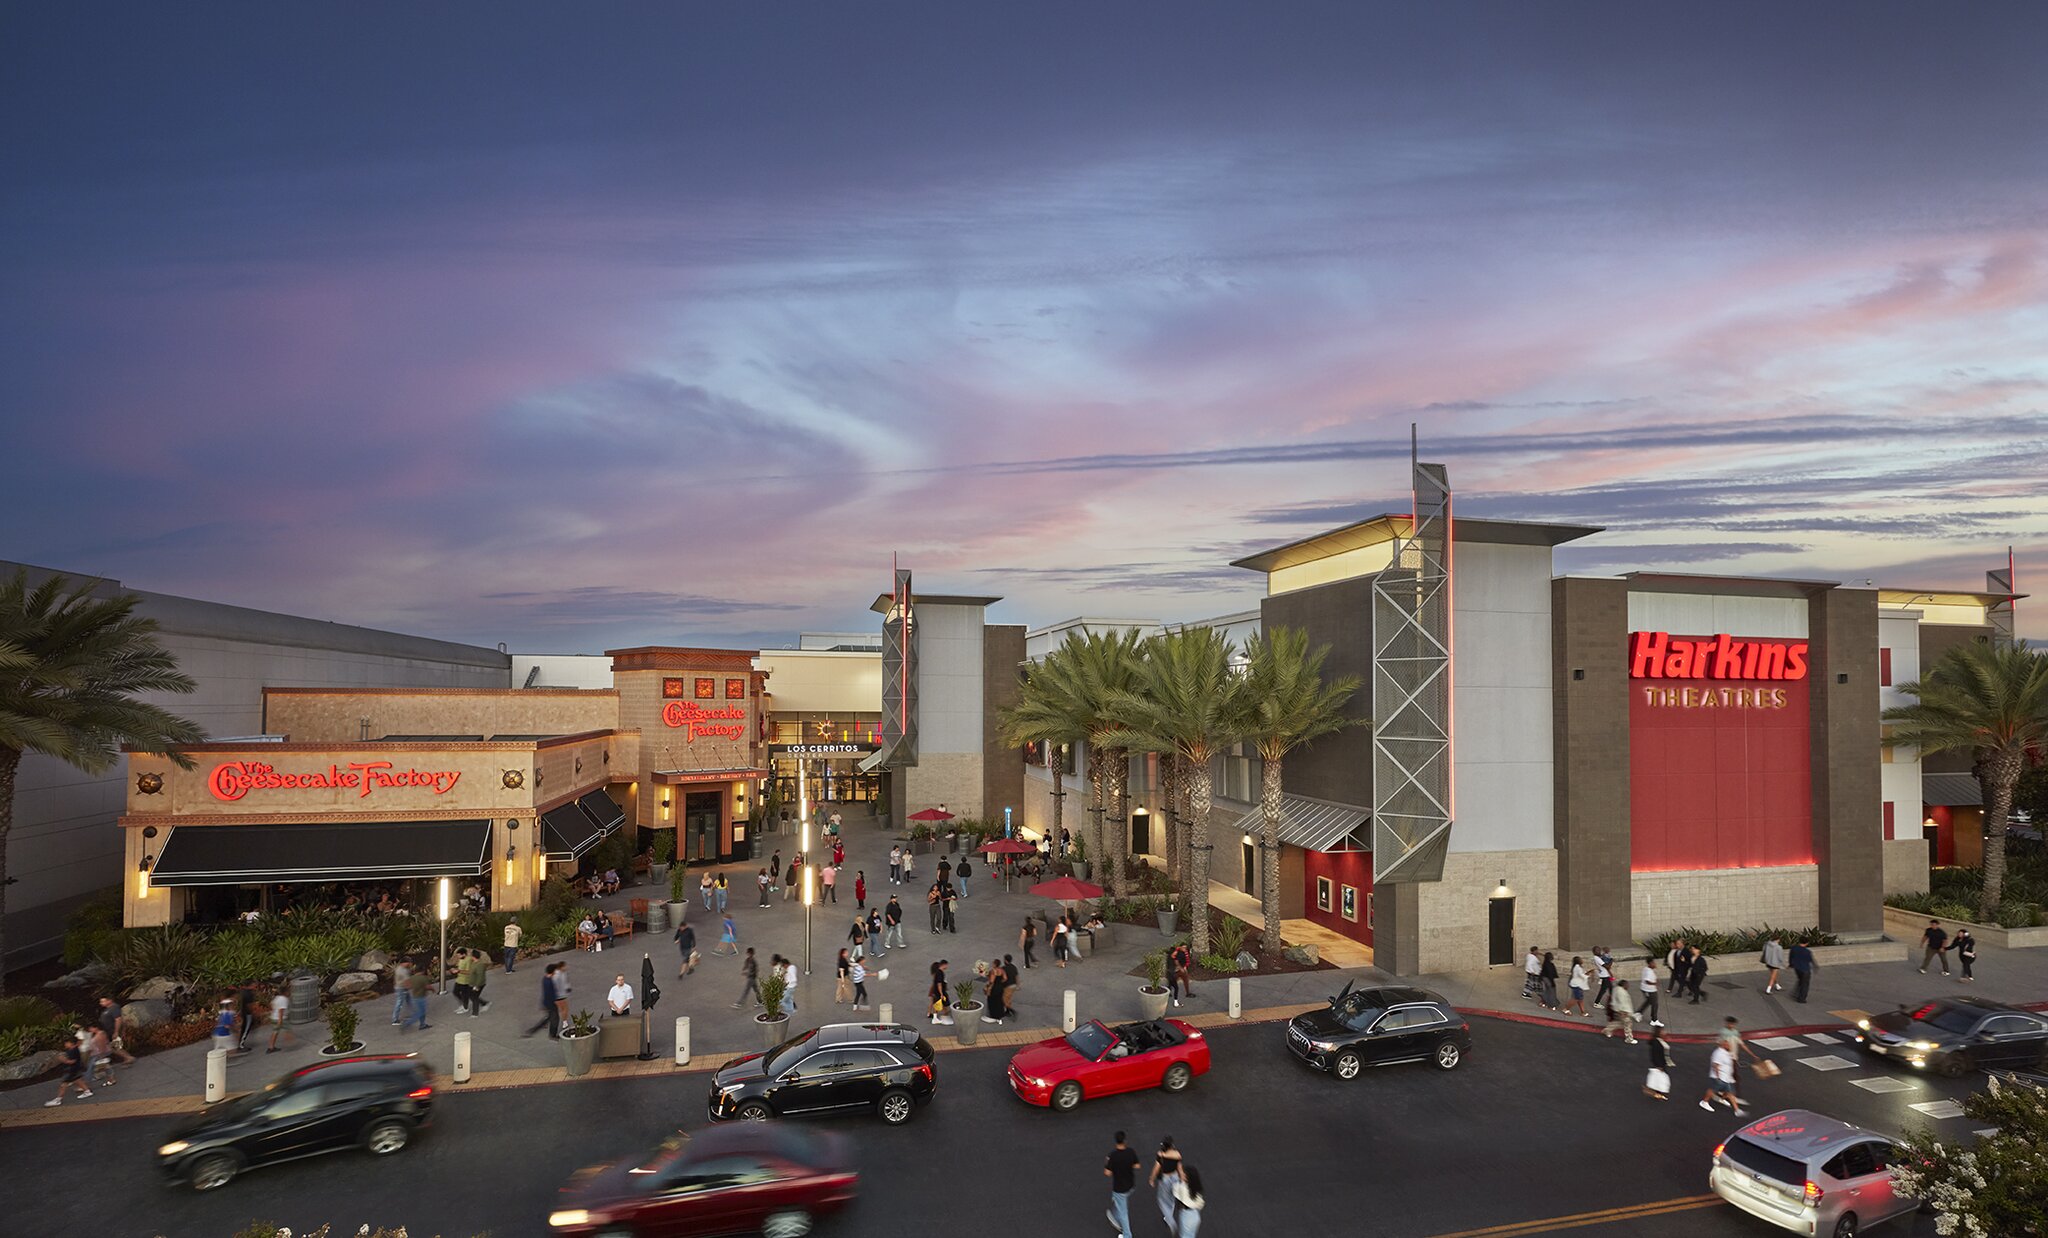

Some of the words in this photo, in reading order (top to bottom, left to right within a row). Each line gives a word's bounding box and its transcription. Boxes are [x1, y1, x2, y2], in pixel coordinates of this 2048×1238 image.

[1631, 631, 1808, 680] Harkins
[1647, 687, 1788, 709] THEATRES
[662, 701, 745, 728] Cheesecake
[681, 718, 745, 744] Factory
[787, 745, 806, 753] LOS
[809, 744, 858, 753] CERRITOS
[246, 761, 274, 773] The
[347, 761, 461, 798] Factory
[207, 761, 359, 800] Cheesecake
